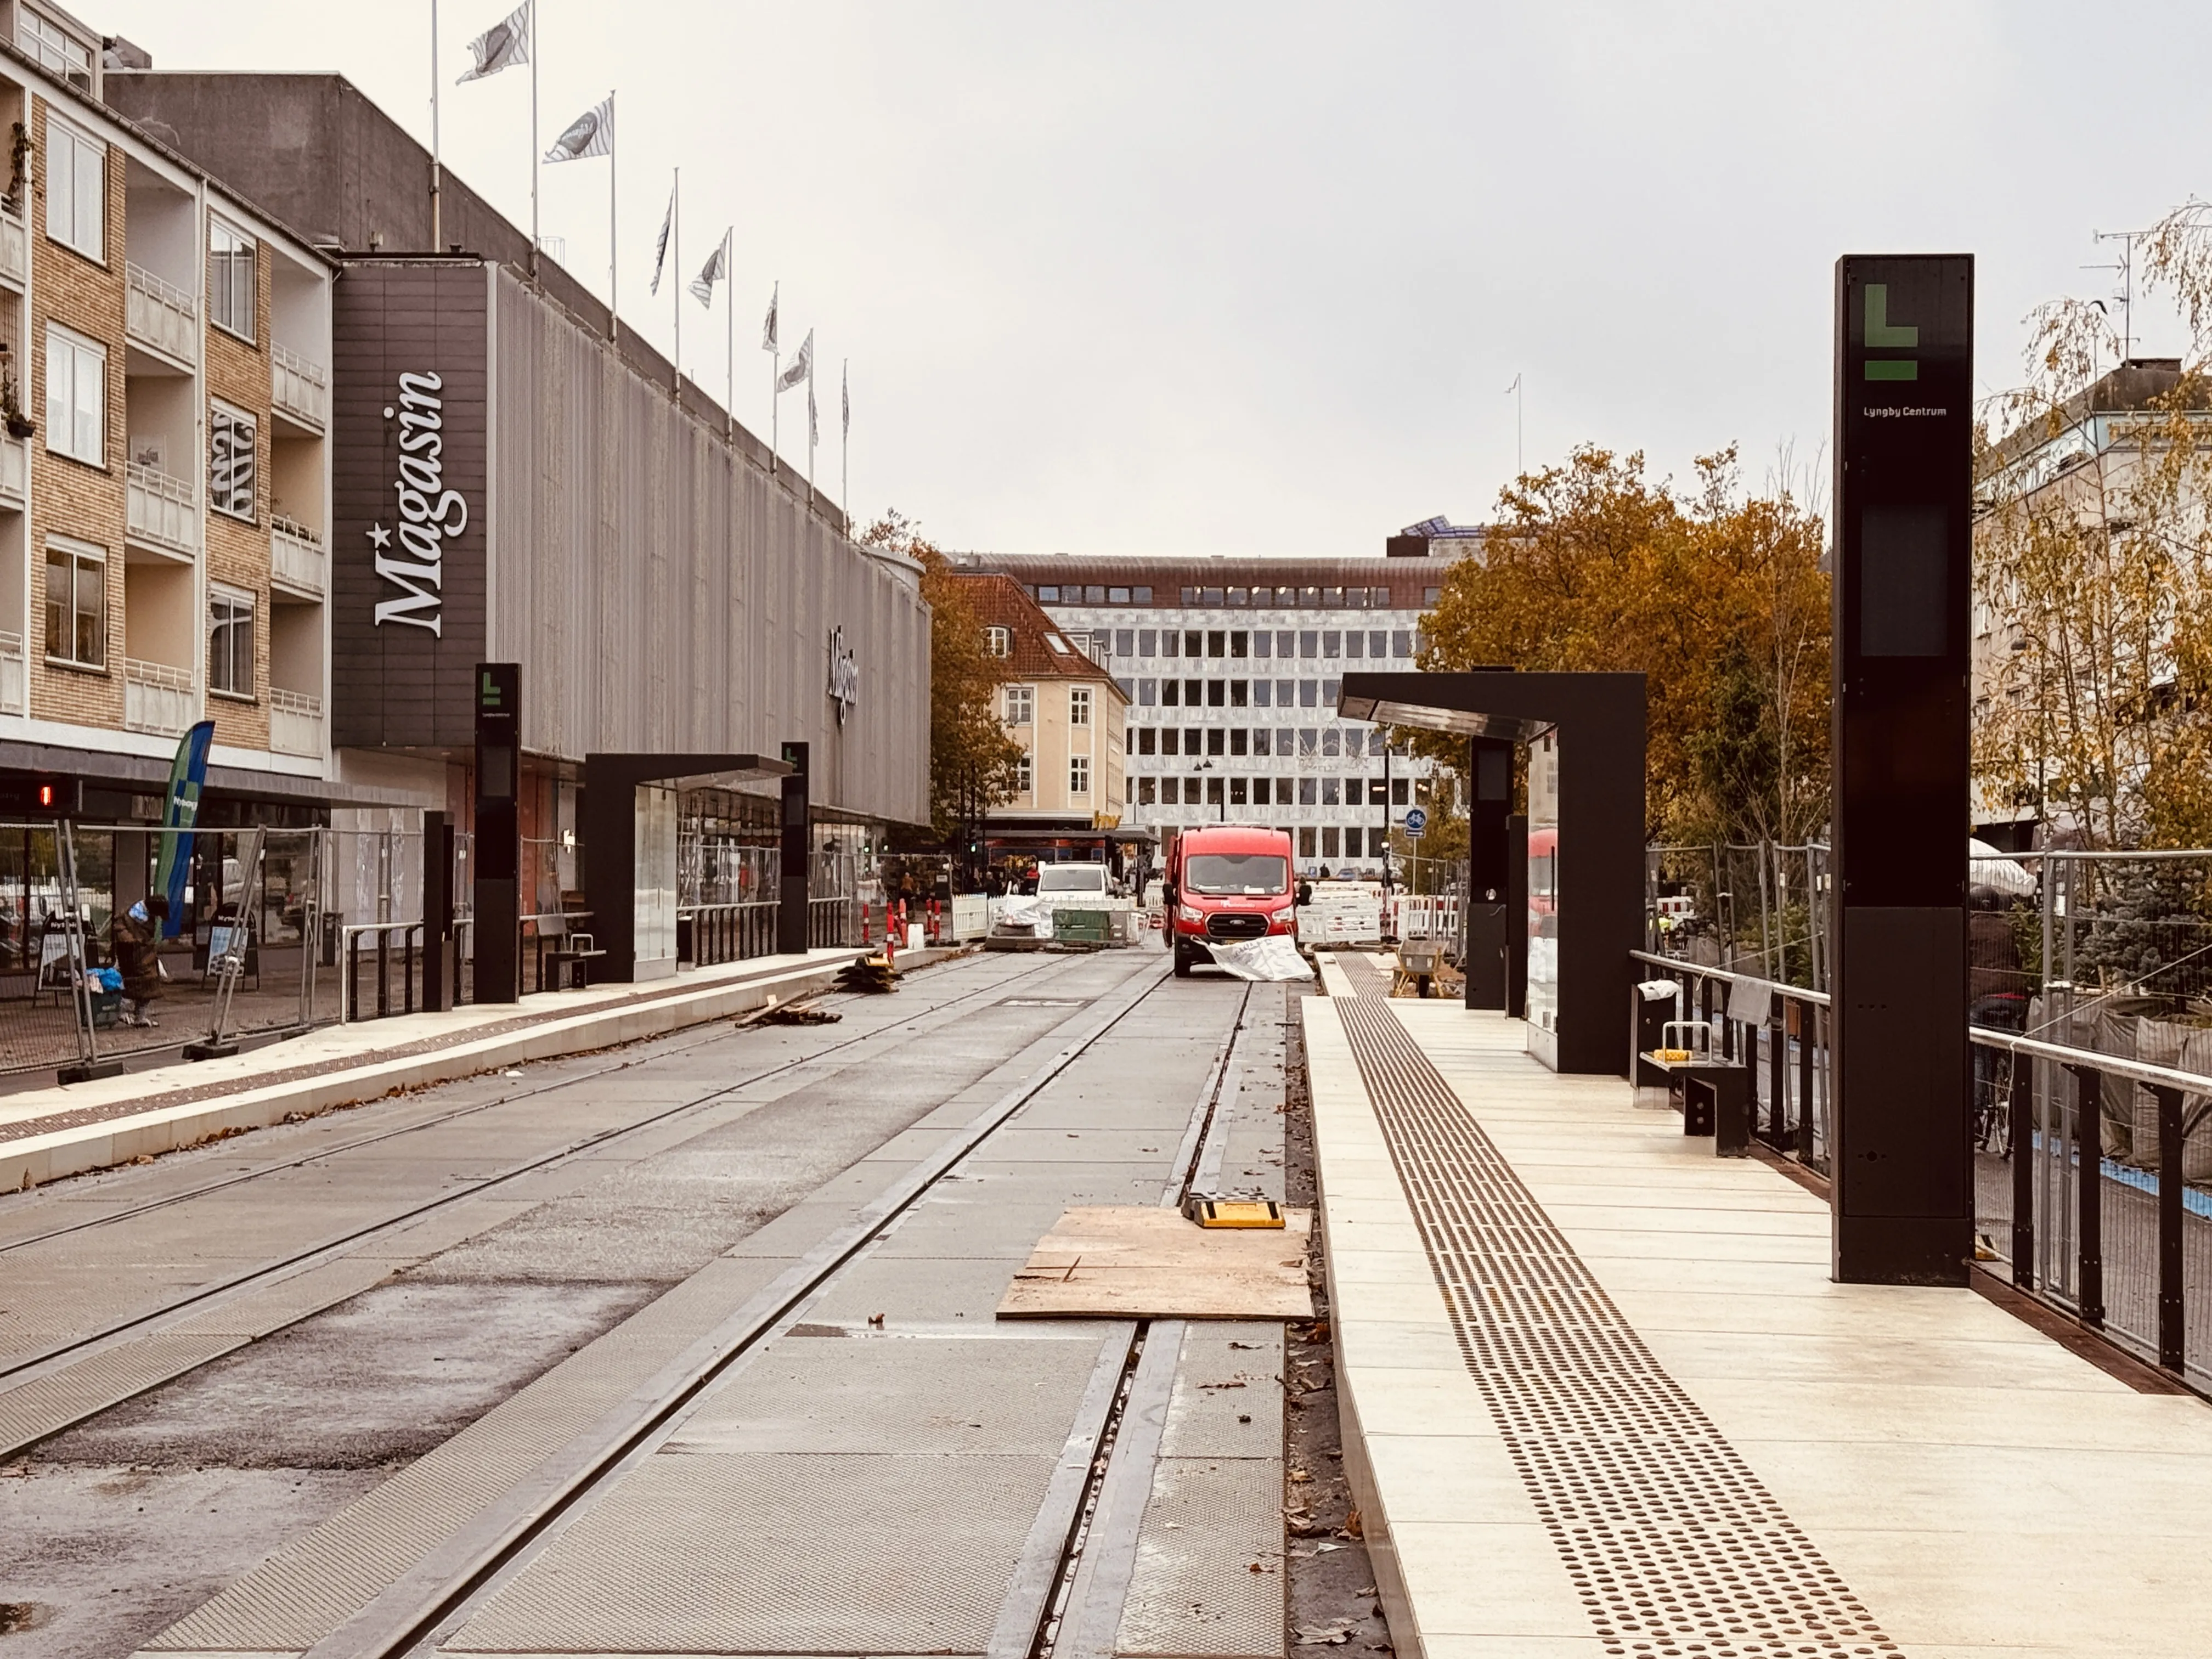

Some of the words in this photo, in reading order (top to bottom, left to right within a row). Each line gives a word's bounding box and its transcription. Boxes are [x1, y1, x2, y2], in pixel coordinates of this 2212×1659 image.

[1864, 407, 1900, 417] Lyngby
[1903, 407, 1947, 416] Centrum
[374, 370, 468, 639] Magasin
